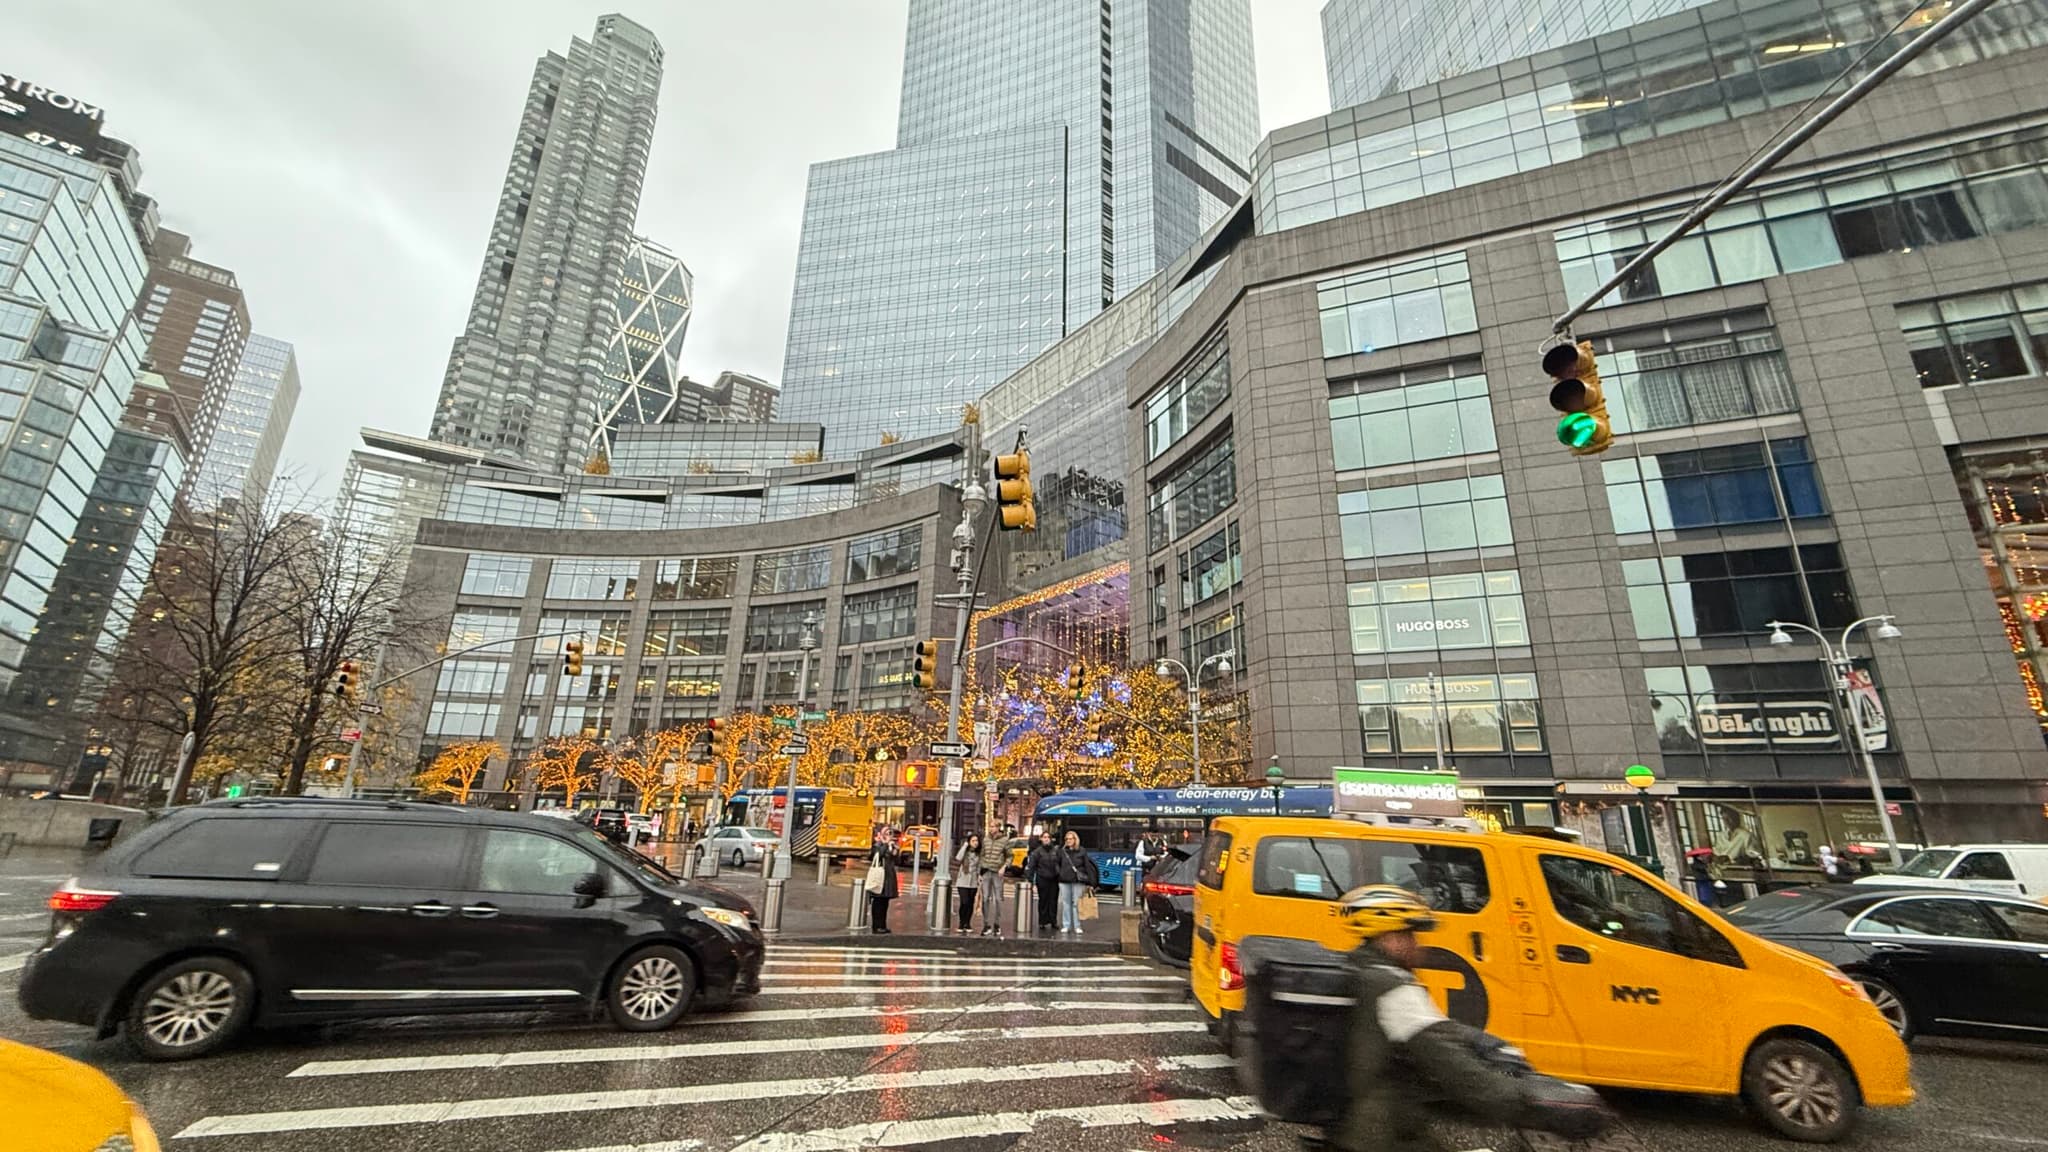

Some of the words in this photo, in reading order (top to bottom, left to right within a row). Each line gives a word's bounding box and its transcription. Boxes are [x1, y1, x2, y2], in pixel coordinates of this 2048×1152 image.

[24, 131, 56, 146] 47
[1396, 620, 1435, 633] HUGO
[1436, 618, 1470, 631] BOSS
[1446, 682, 1480, 694] BOSS
[1176, 788, 1259, 801] clean-energy
[1610, 984, 1661, 1005] NYC
